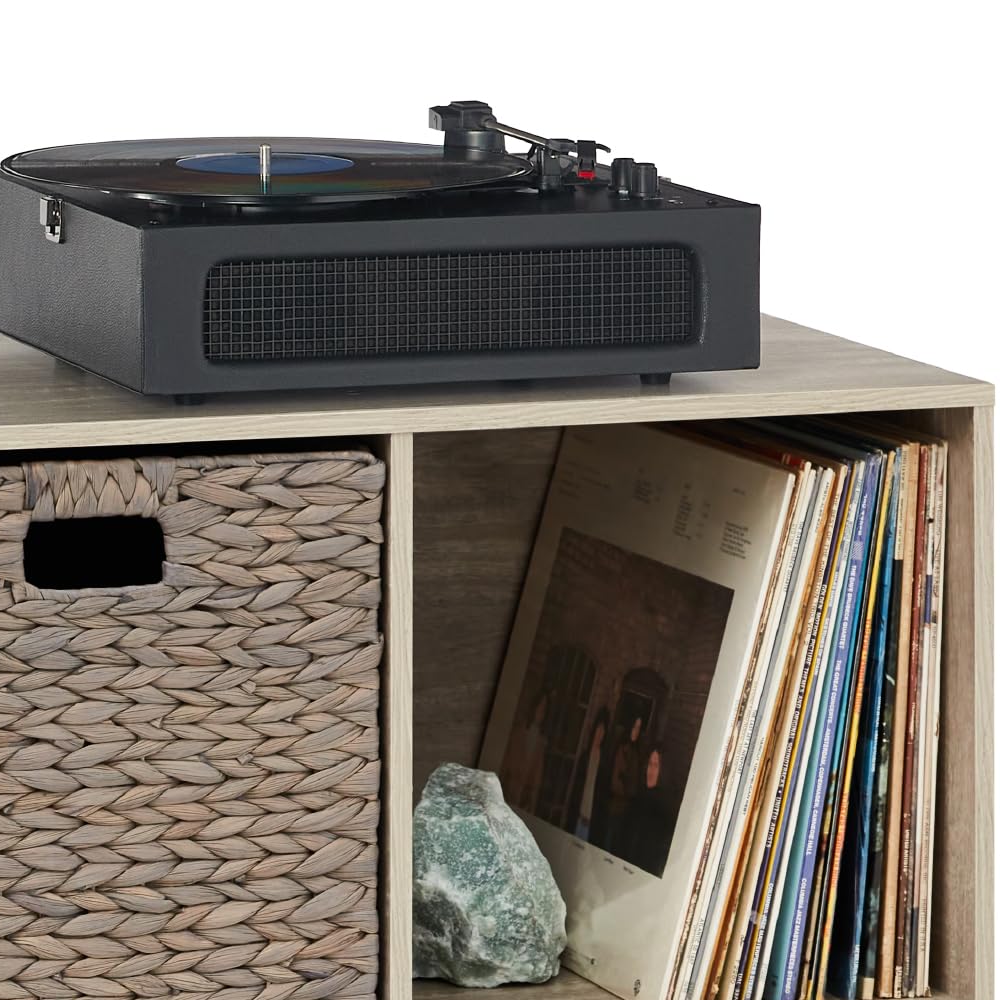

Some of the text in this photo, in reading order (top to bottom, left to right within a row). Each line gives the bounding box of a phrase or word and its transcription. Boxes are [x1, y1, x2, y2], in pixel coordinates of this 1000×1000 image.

[838, 621, 848, 649] QUARTET
[834, 658, 842, 671] THE
[831, 670, 840, 692] GREAT
[807, 808, 818, 841] CARNEGIE
[805, 839, 813, 856] HALL
[797, 877, 808, 909] COLUMBIA
[794, 908, 803, 925] JAZZ
[787, 924, 800, 970] MASTERPIECES
[783, 969, 793, 994] STEREO
